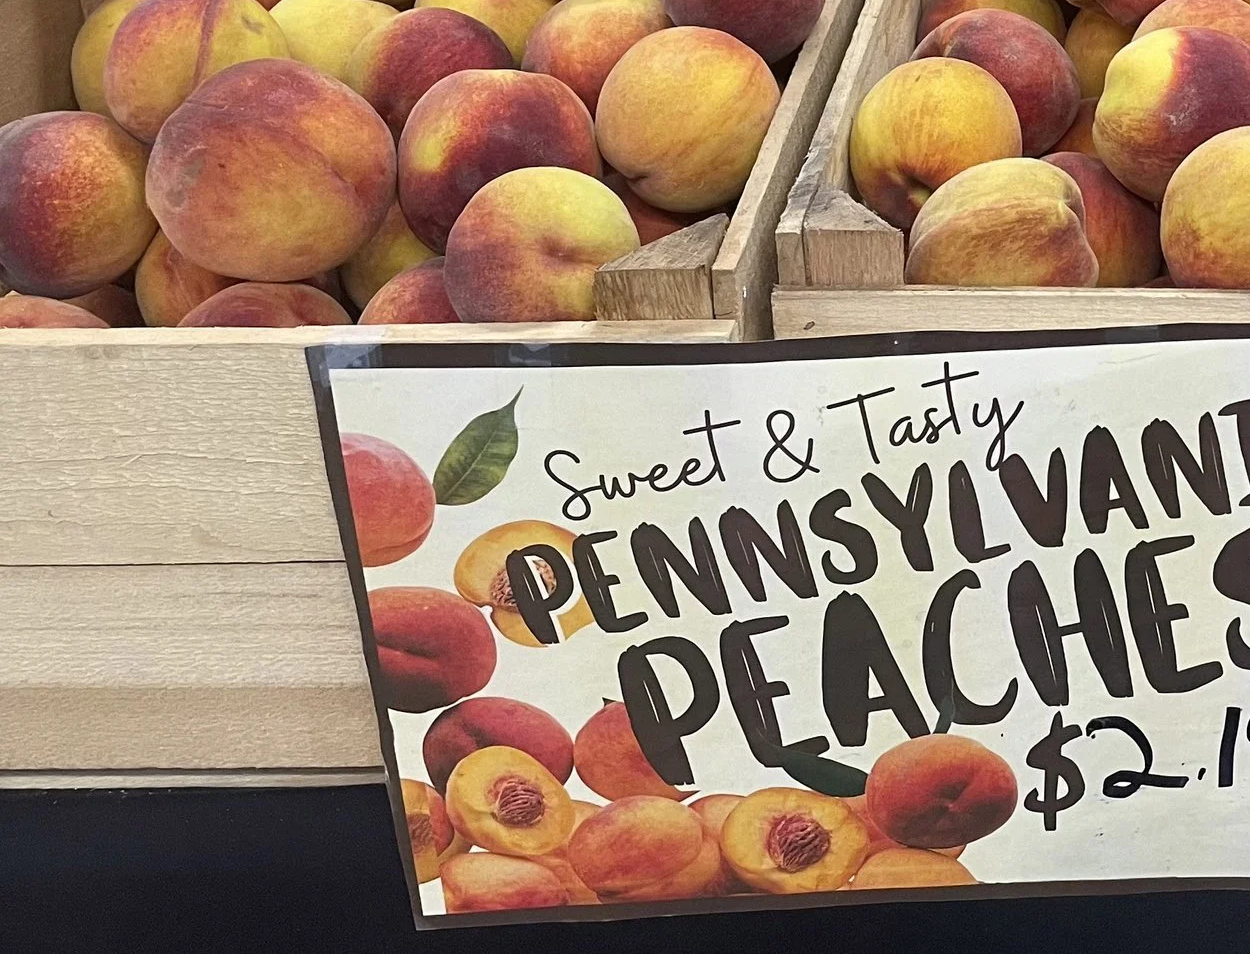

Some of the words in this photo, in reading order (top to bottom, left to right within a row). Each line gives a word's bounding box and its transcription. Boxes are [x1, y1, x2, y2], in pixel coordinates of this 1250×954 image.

[543, 409, 741, 521] Sweet
[762, 409, 820, 483] &
[826, 361, 1025, 472] Tasty
